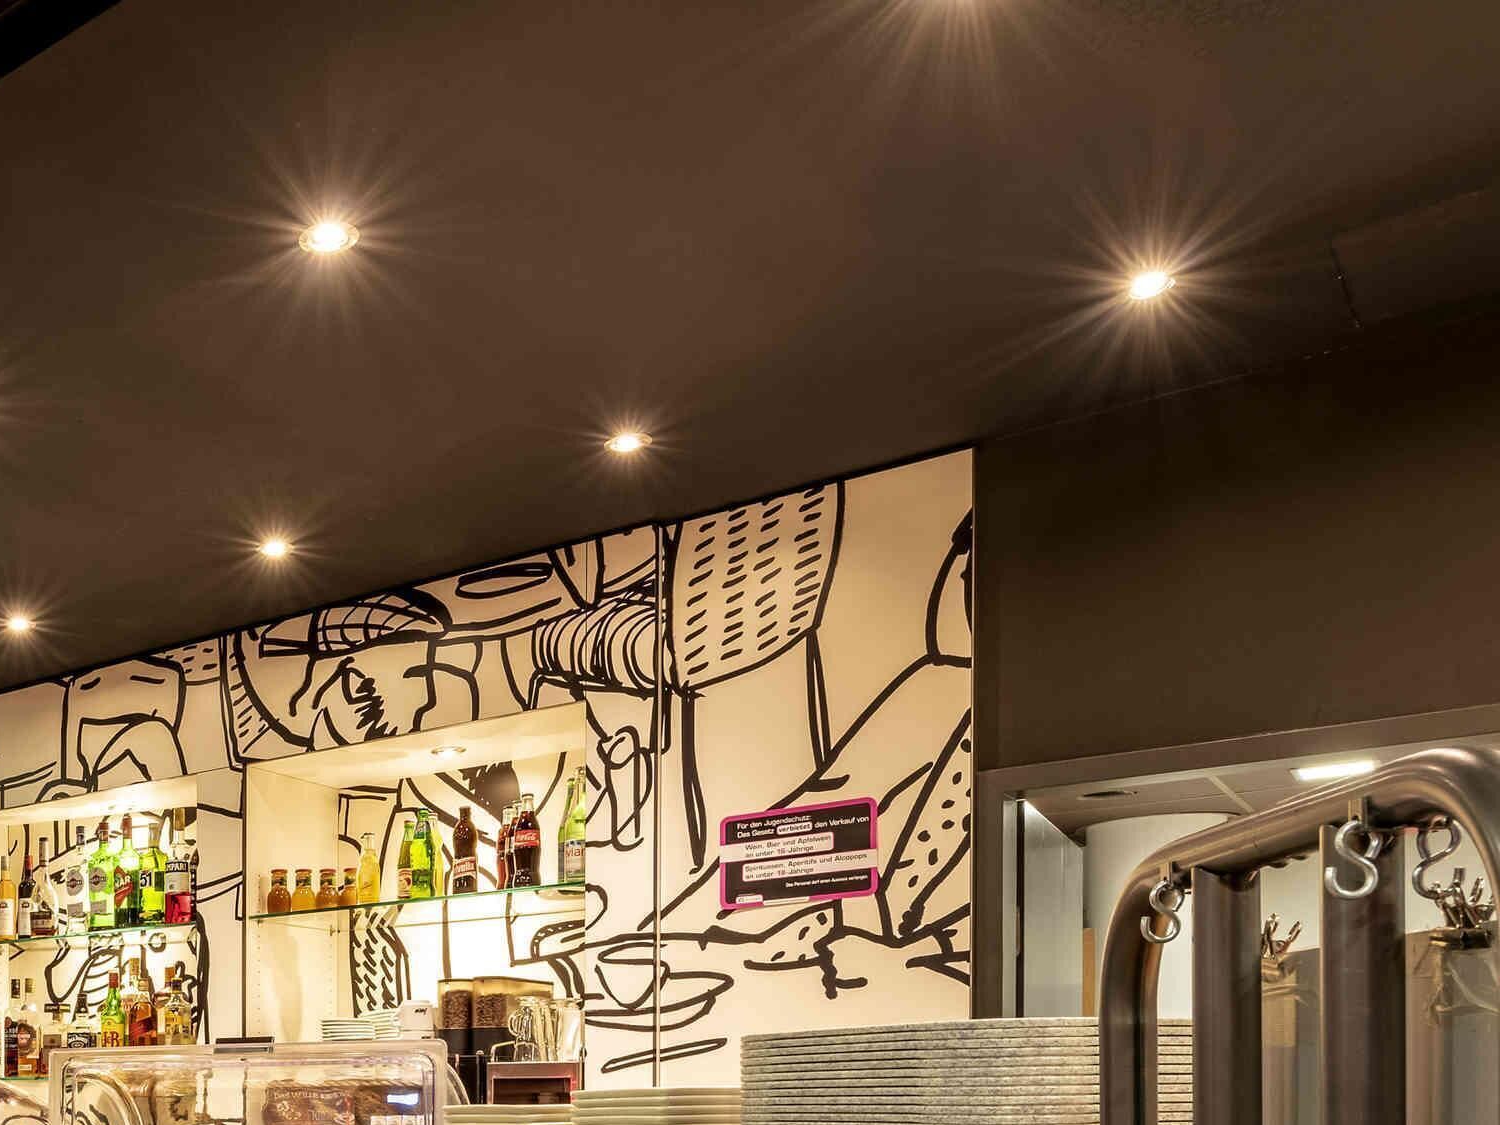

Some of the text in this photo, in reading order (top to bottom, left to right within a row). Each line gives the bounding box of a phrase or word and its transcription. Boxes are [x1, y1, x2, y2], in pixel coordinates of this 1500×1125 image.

[778, 823, 810, 832] verbietet
[829, 817, 855, 826] Verkauf
[835, 853, 867, 862] Alcopops
[140, 872, 153, 888] 51
[755, 871, 774, 879] unter
